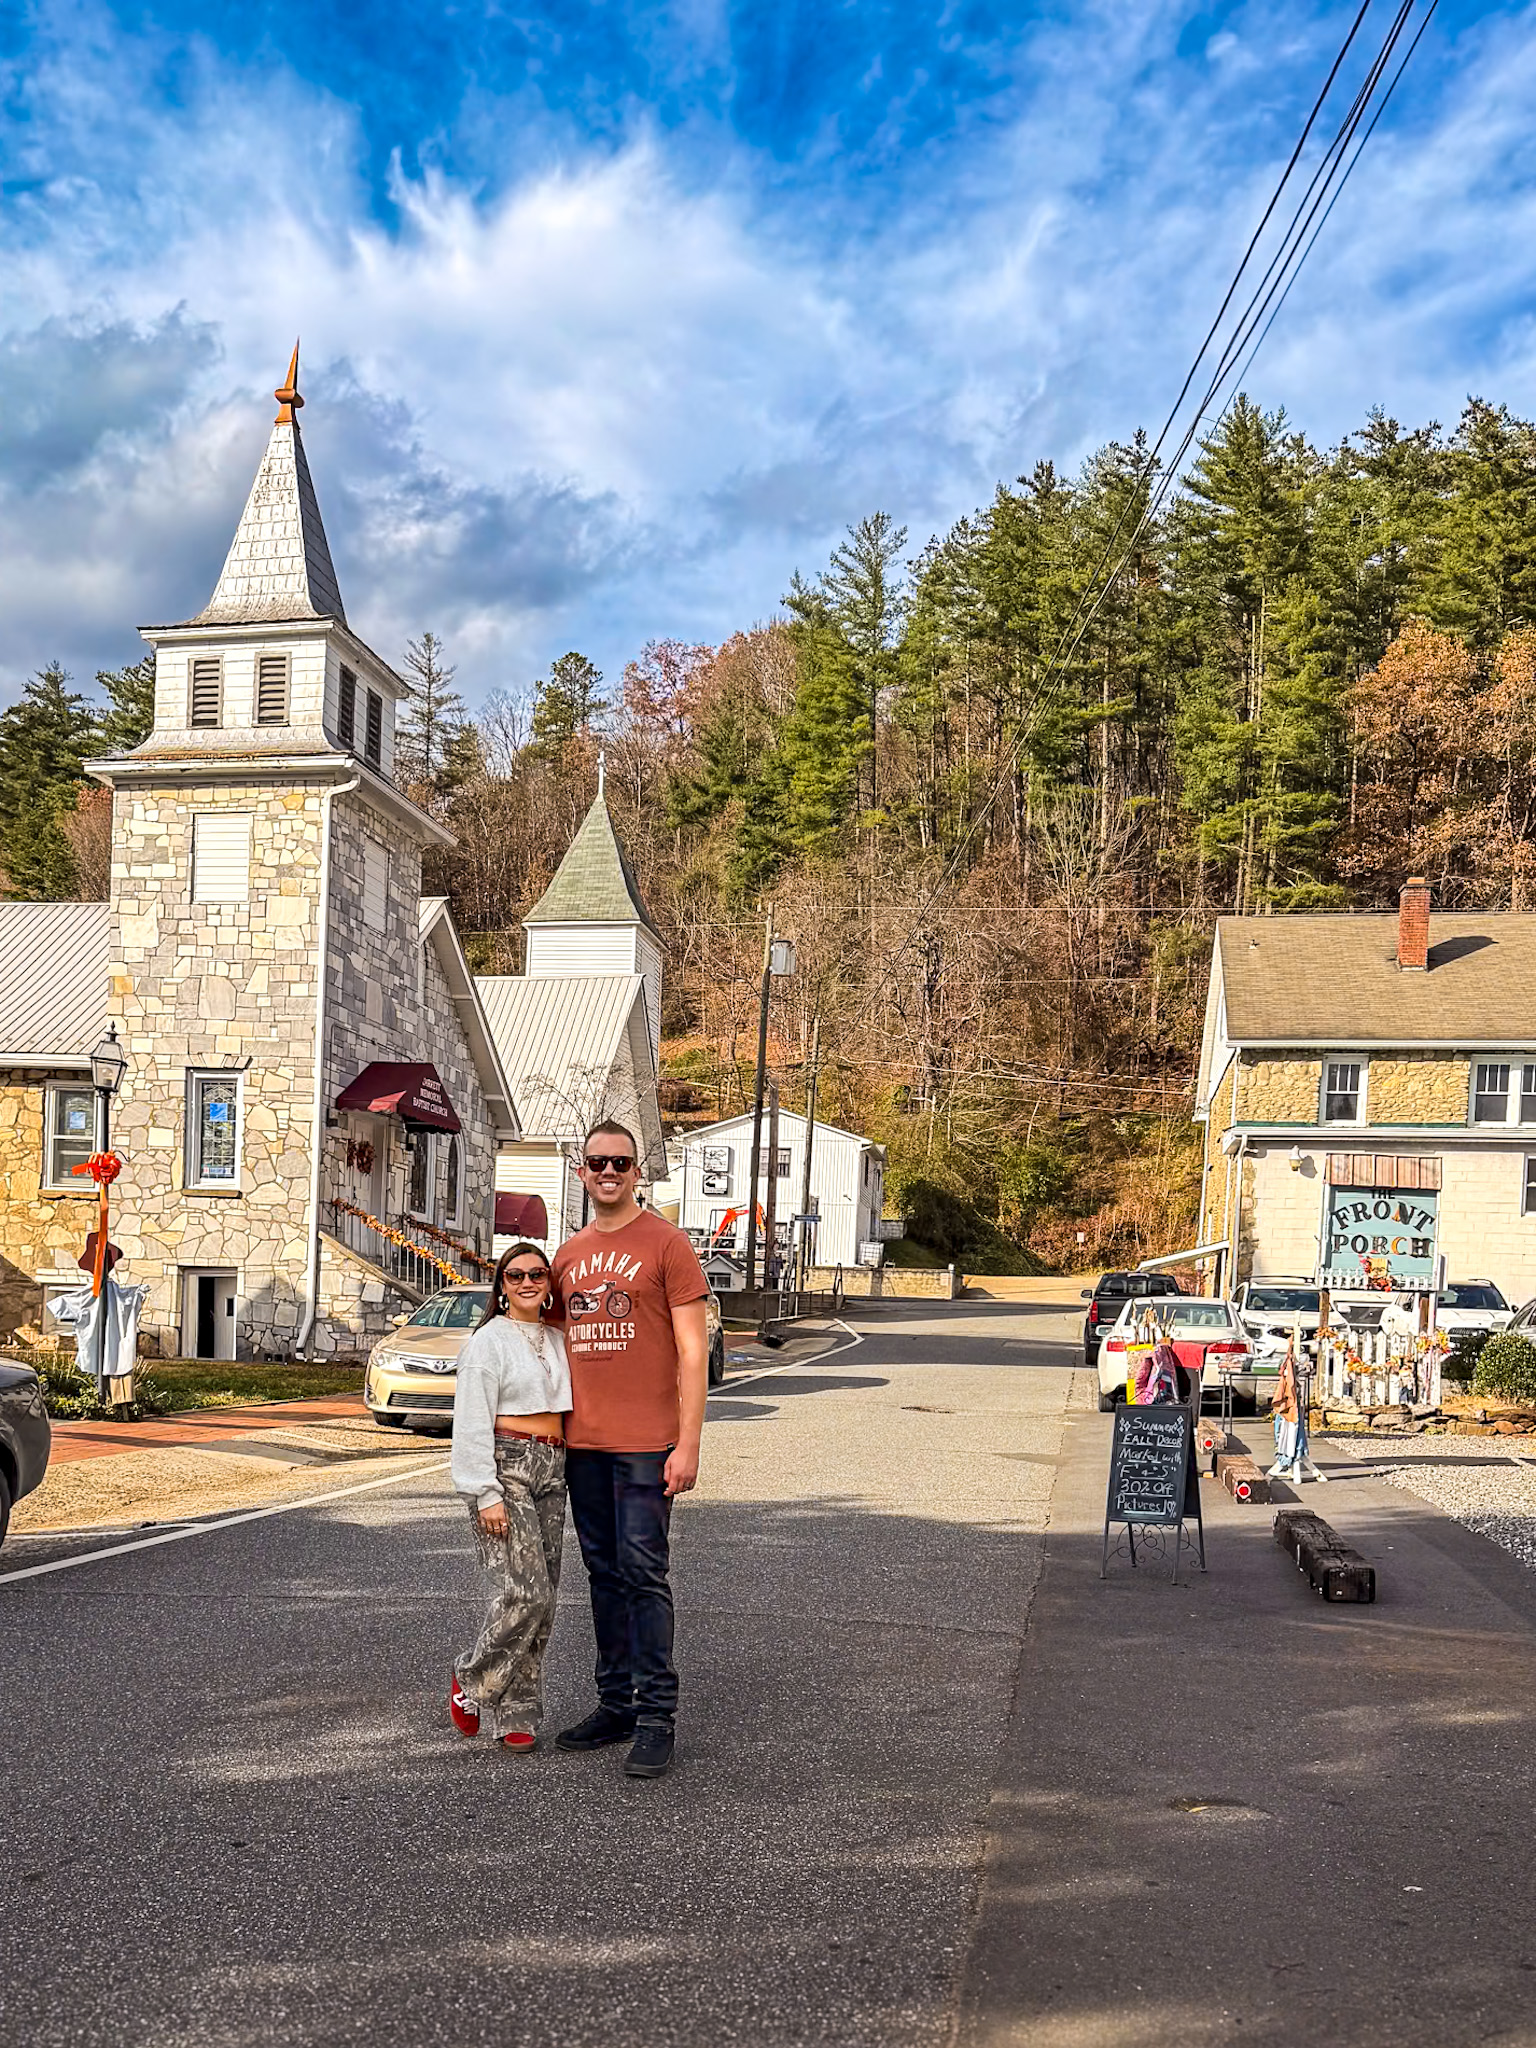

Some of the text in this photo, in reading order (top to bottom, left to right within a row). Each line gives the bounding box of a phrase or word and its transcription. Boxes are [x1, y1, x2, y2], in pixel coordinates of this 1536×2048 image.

[430, 1103, 448, 1117] CHURCH
[1370, 1189, 1396, 1200] THE
[1330, 1199, 1436, 1233] FRONT
[1331, 1234, 1434, 1259] PORCH
[569, 1251, 643, 1285] YAMAHA
[568, 1322, 636, 1342] MOTORCYCLES
[593, 1341, 628, 1352] PRODUCT
[1121, 1433, 1154, 1446] FALL
[1119, 1447, 1160, 1462] Marked
[1120, 1478, 1151, 1494] 30%
[1115, 1492, 1161, 1512] Pictures
